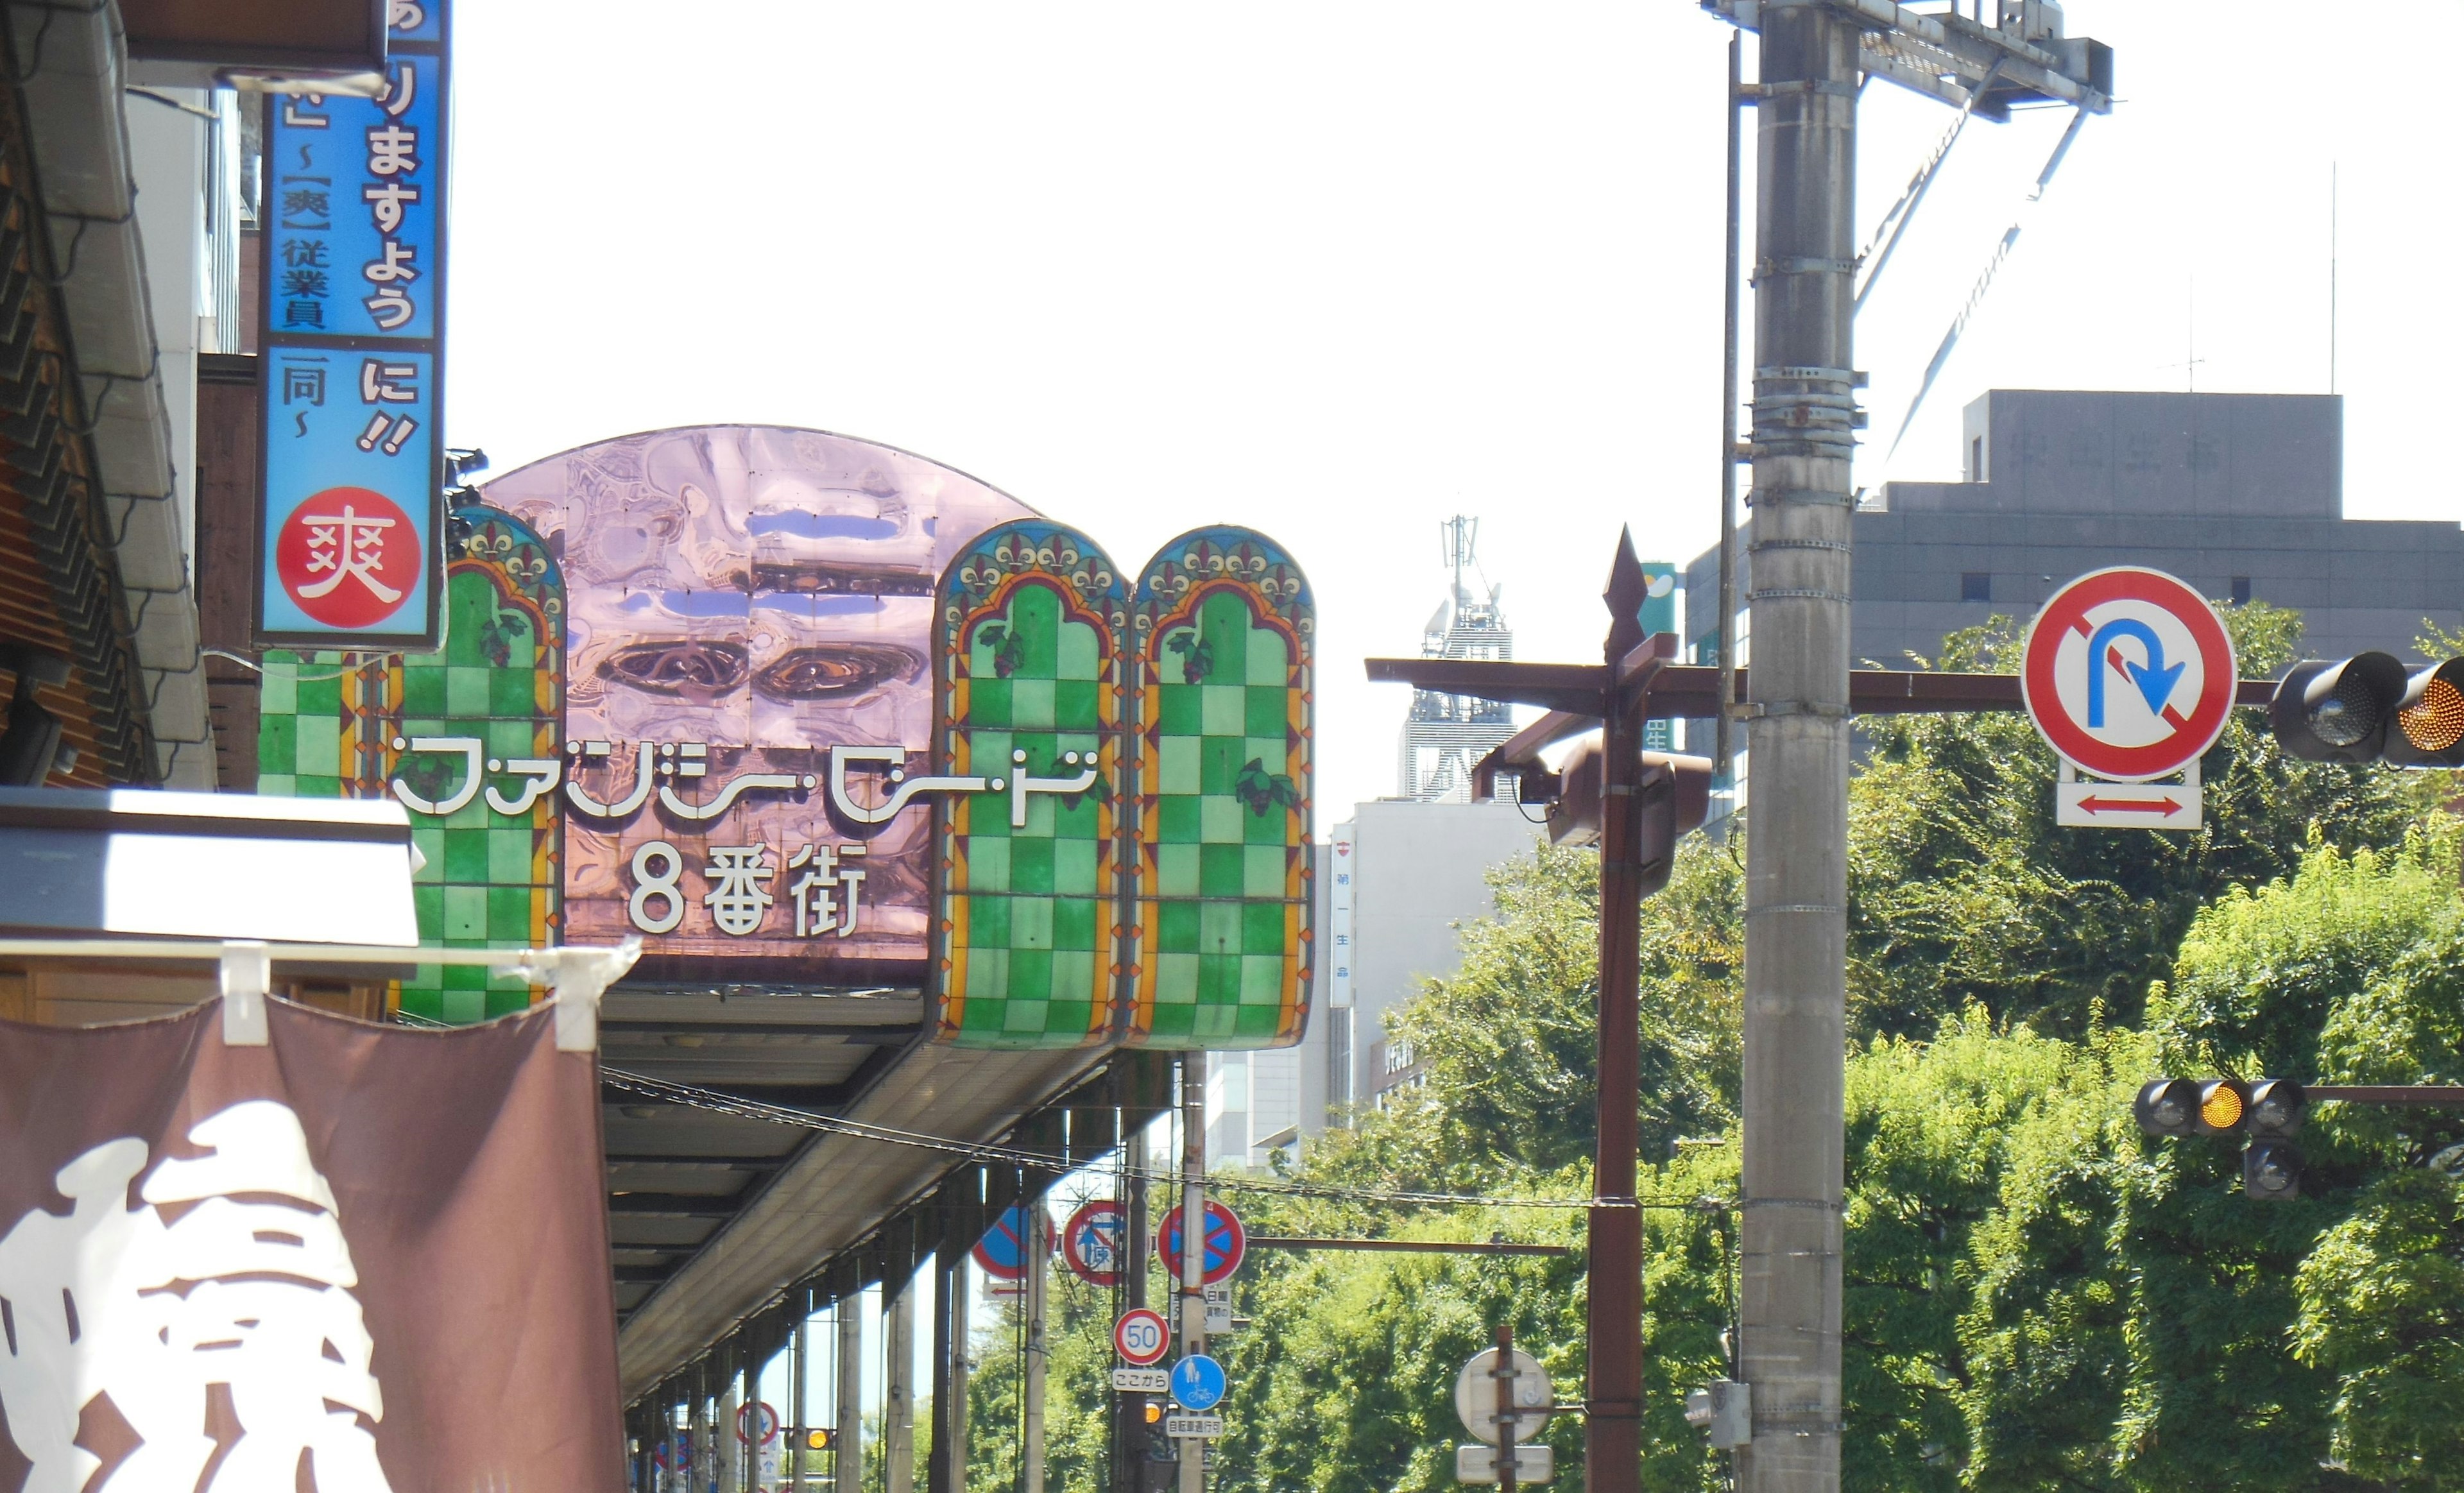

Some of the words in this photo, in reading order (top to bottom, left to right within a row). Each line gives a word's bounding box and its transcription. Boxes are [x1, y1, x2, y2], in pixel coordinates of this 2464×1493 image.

[297, 505, 402, 604] 爽
[393, 736, 1098, 827] ファンシーロード
[629, 840, 867, 937] 8番街
[1127, 1325, 1157, 1348] 50
[1115, 1374, 1167, 1388] ここから
[1169, 1420, 1221, 1433] 自転車通行可
